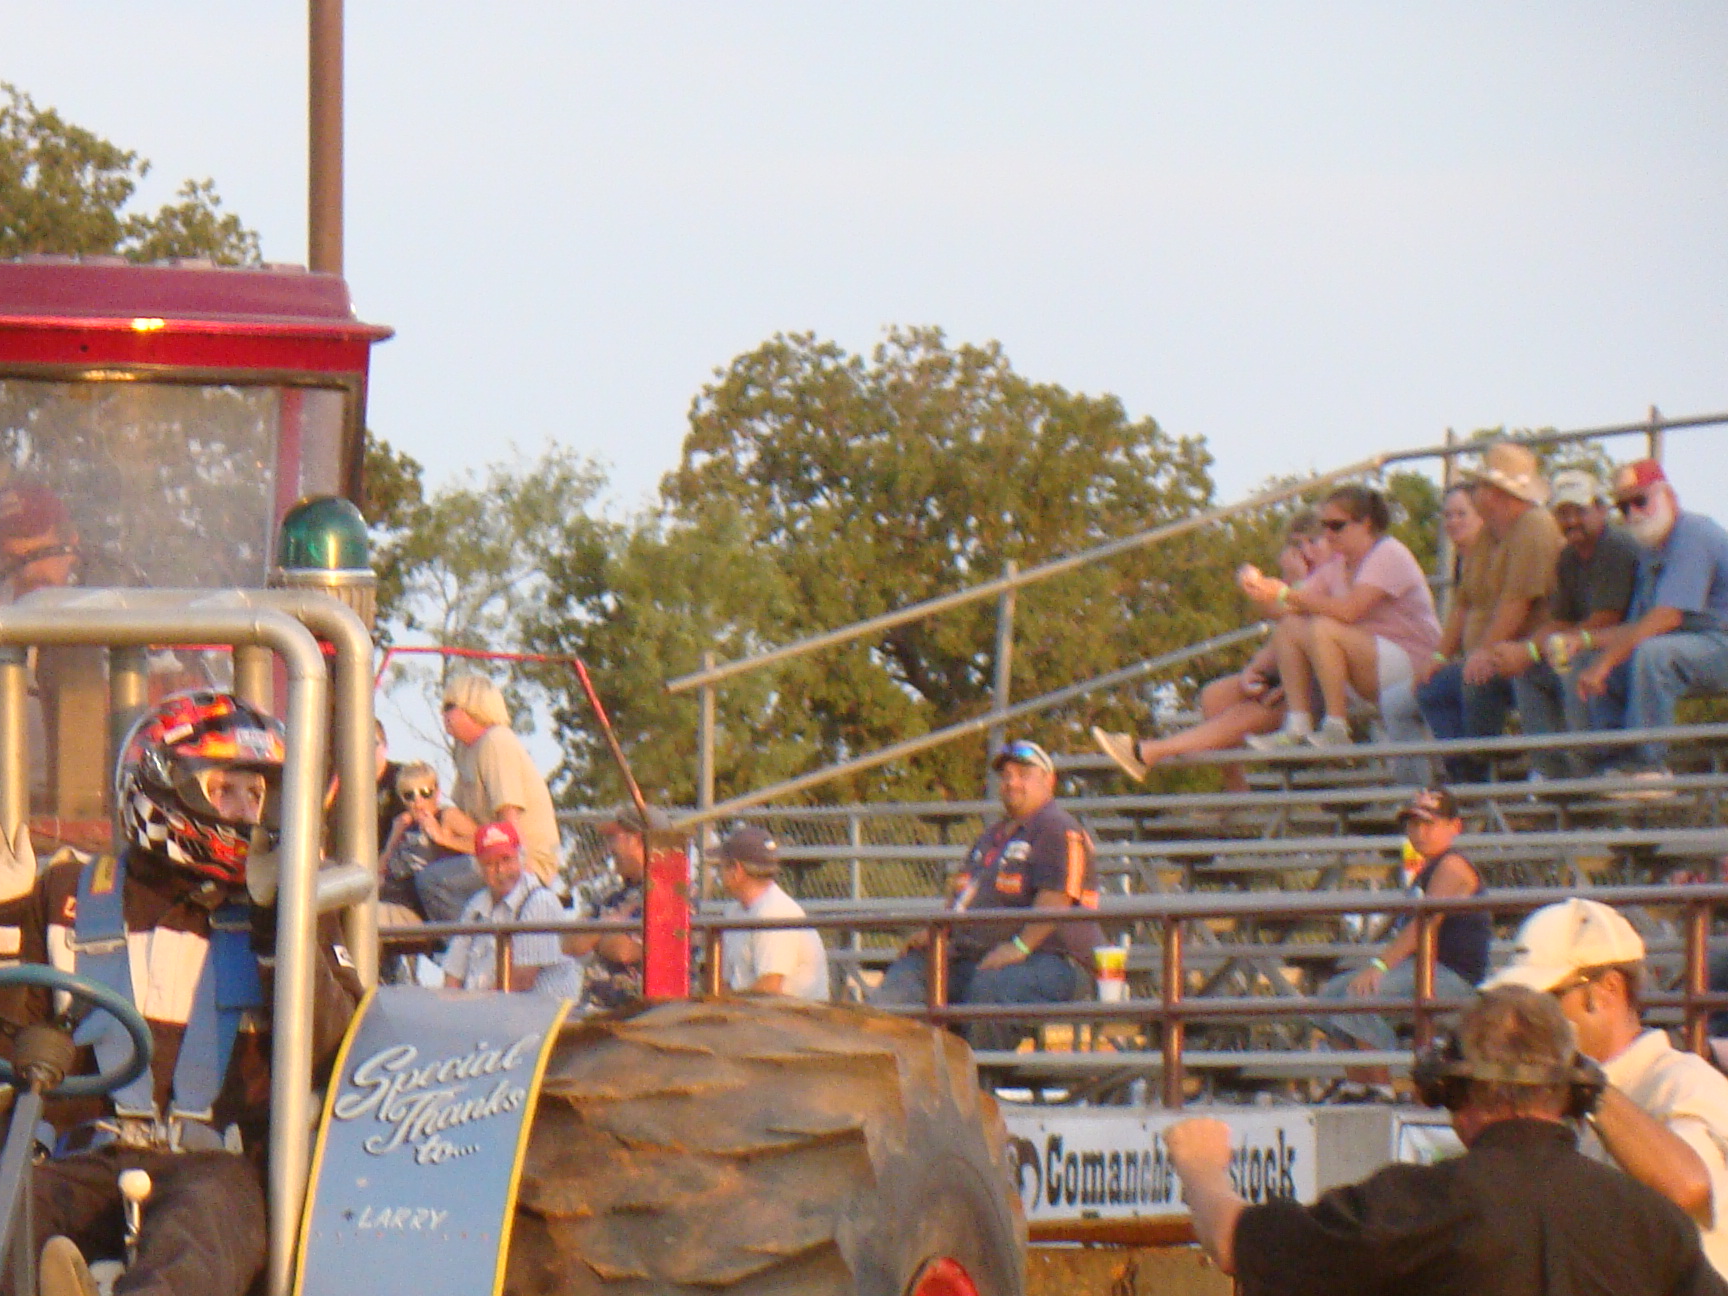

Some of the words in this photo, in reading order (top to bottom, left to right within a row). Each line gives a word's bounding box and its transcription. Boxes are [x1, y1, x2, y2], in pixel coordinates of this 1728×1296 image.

[335, 1034, 542, 1121] Special
[363, 1080, 527, 1155] Thanks
[358, 1204, 448, 1230] LARRY
